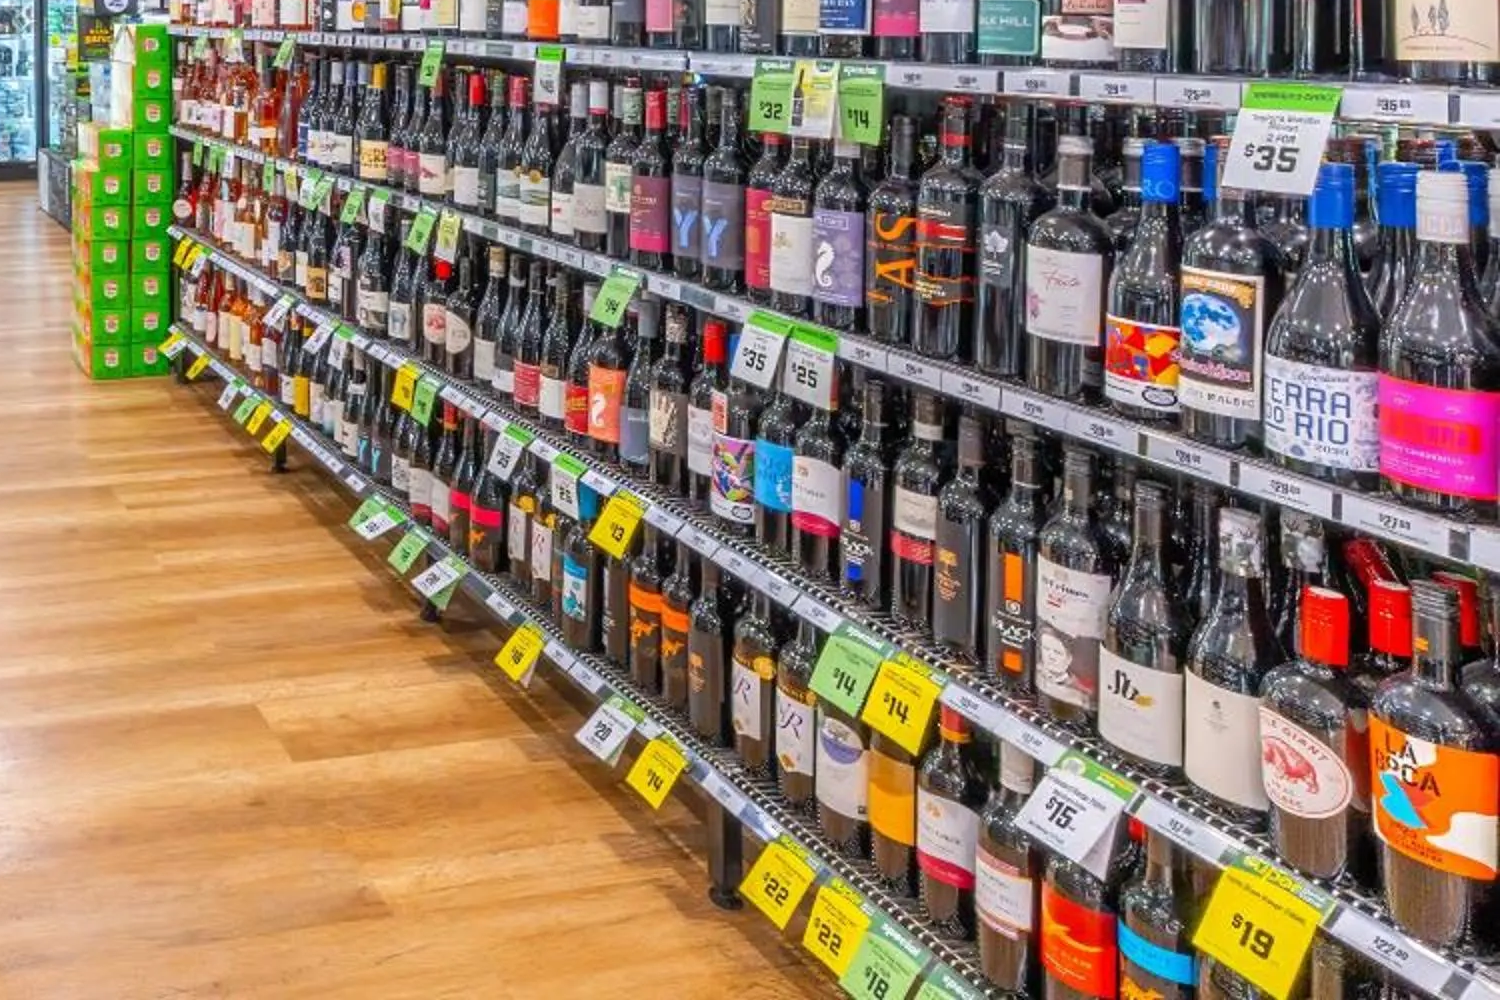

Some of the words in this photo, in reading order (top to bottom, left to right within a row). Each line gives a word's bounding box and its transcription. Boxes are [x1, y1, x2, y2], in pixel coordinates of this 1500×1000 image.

[759, 101, 784, 120] $32
[848, 107, 870, 129] $14
[1244, 144, 1300, 173] $35
[743, 347, 767, 372] $35
[791, 363, 819, 389] $25
[1270, 378, 1351, 418] ERRA
[1295, 411, 1349, 446] RIO
[883, 692, 910, 724] $14
[1045, 796, 1079, 829] $15
[1231, 912, 1275, 961] $19
